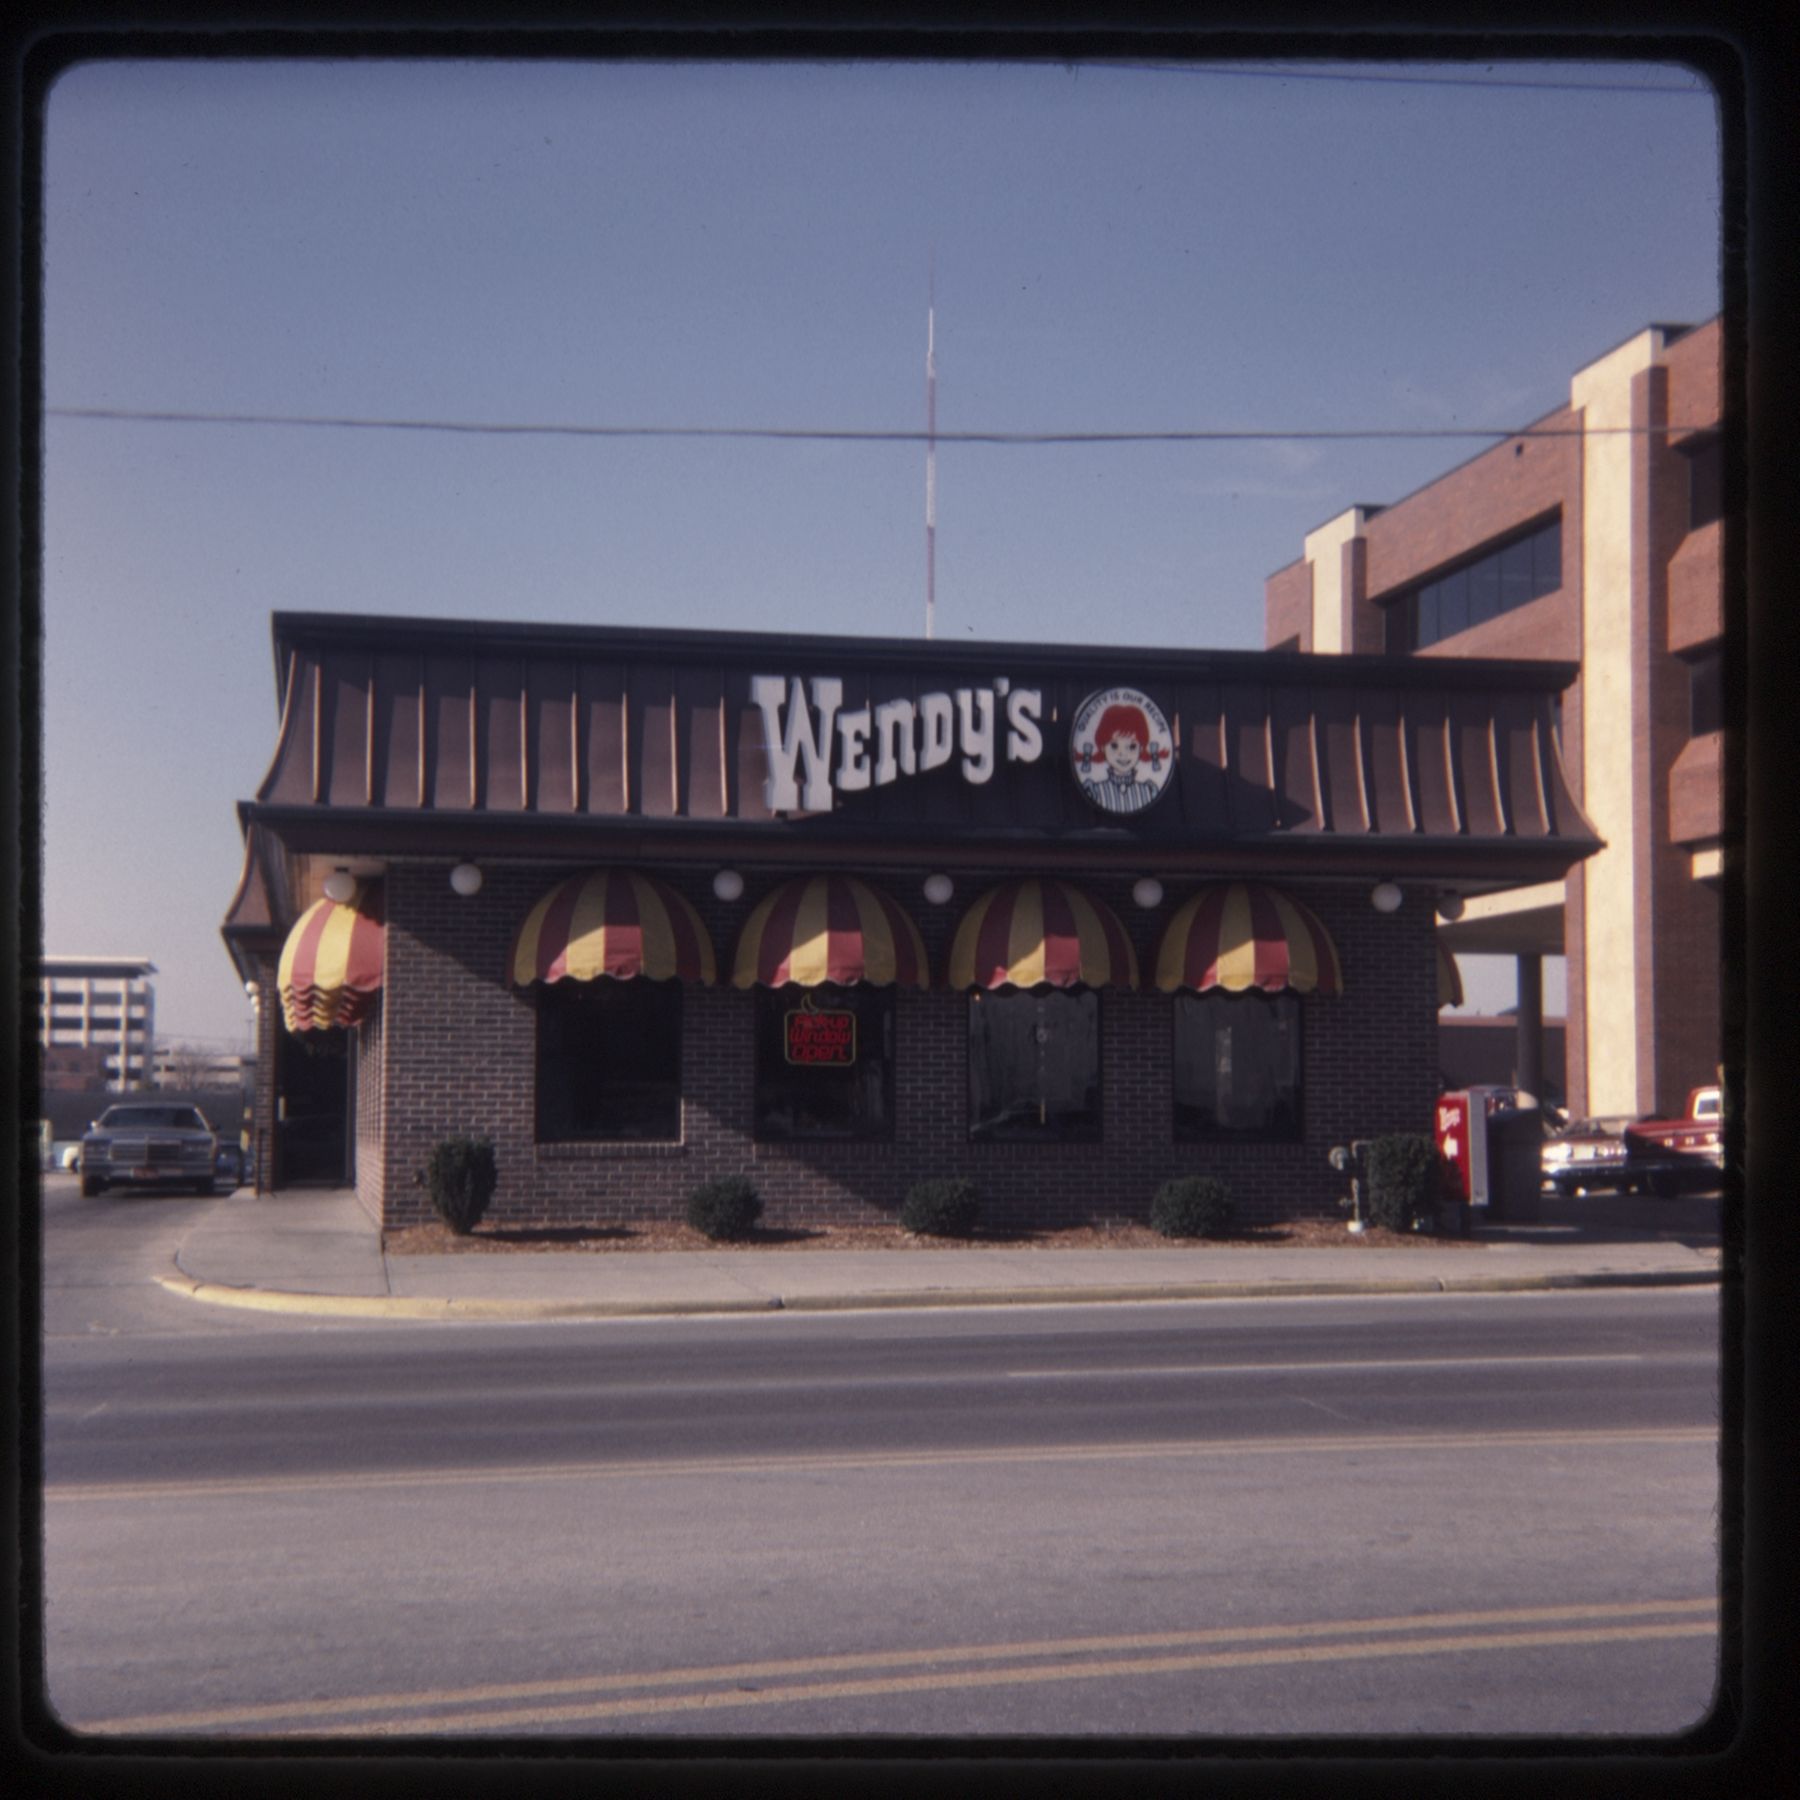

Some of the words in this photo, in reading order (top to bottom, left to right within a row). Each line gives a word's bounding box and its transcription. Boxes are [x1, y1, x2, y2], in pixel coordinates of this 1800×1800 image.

[751, 675, 1043, 812] Wendy's
[1078, 693, 1108, 731] QUALITY
[1109, 690, 1120, 701] IS
[1122, 690, 1143, 704] OUR
[1144, 701, 1168, 733] RECIPE
